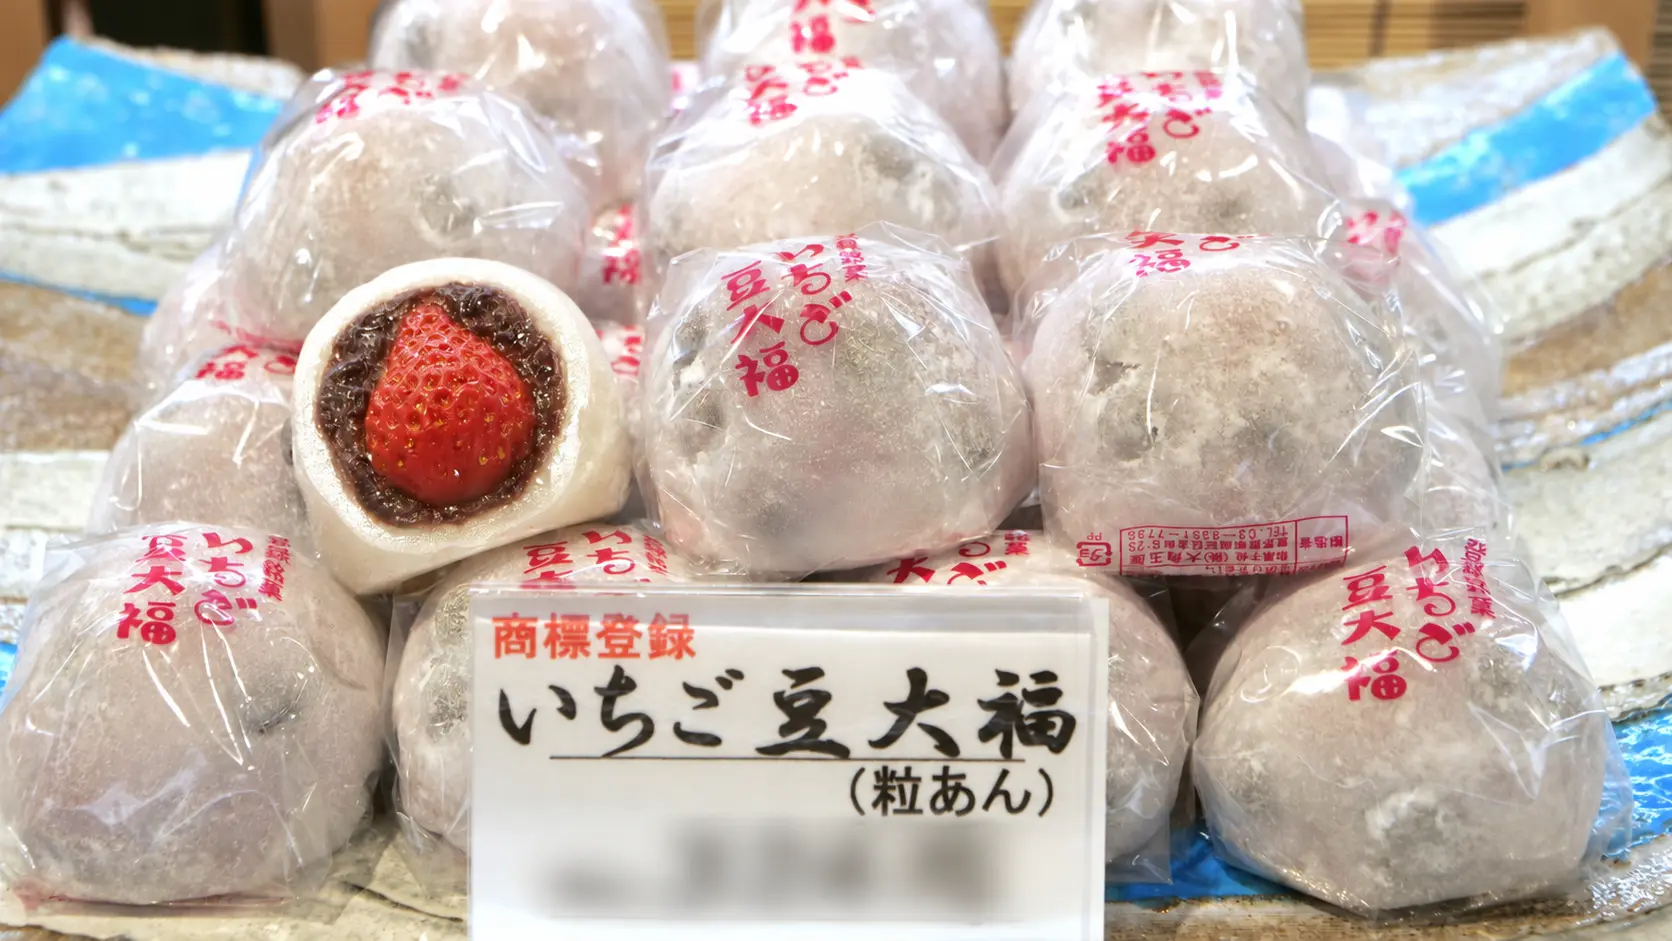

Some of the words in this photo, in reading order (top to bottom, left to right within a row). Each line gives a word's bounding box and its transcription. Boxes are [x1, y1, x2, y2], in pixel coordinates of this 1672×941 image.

[721, 260, 800, 398] 豆大福
[775, 244, 853, 346] いちご
[116, 534, 188, 645] 豆大福
[194, 532, 258, 626] いちご
[1404, 545, 1476, 663] いちご
[493, 613, 697, 661] 商標登録
[1340, 564, 1408, 702] 豆大福
[499, 664, 1077, 759] いちご豆大福
[850, 766, 1055, 817] （粒あん）
